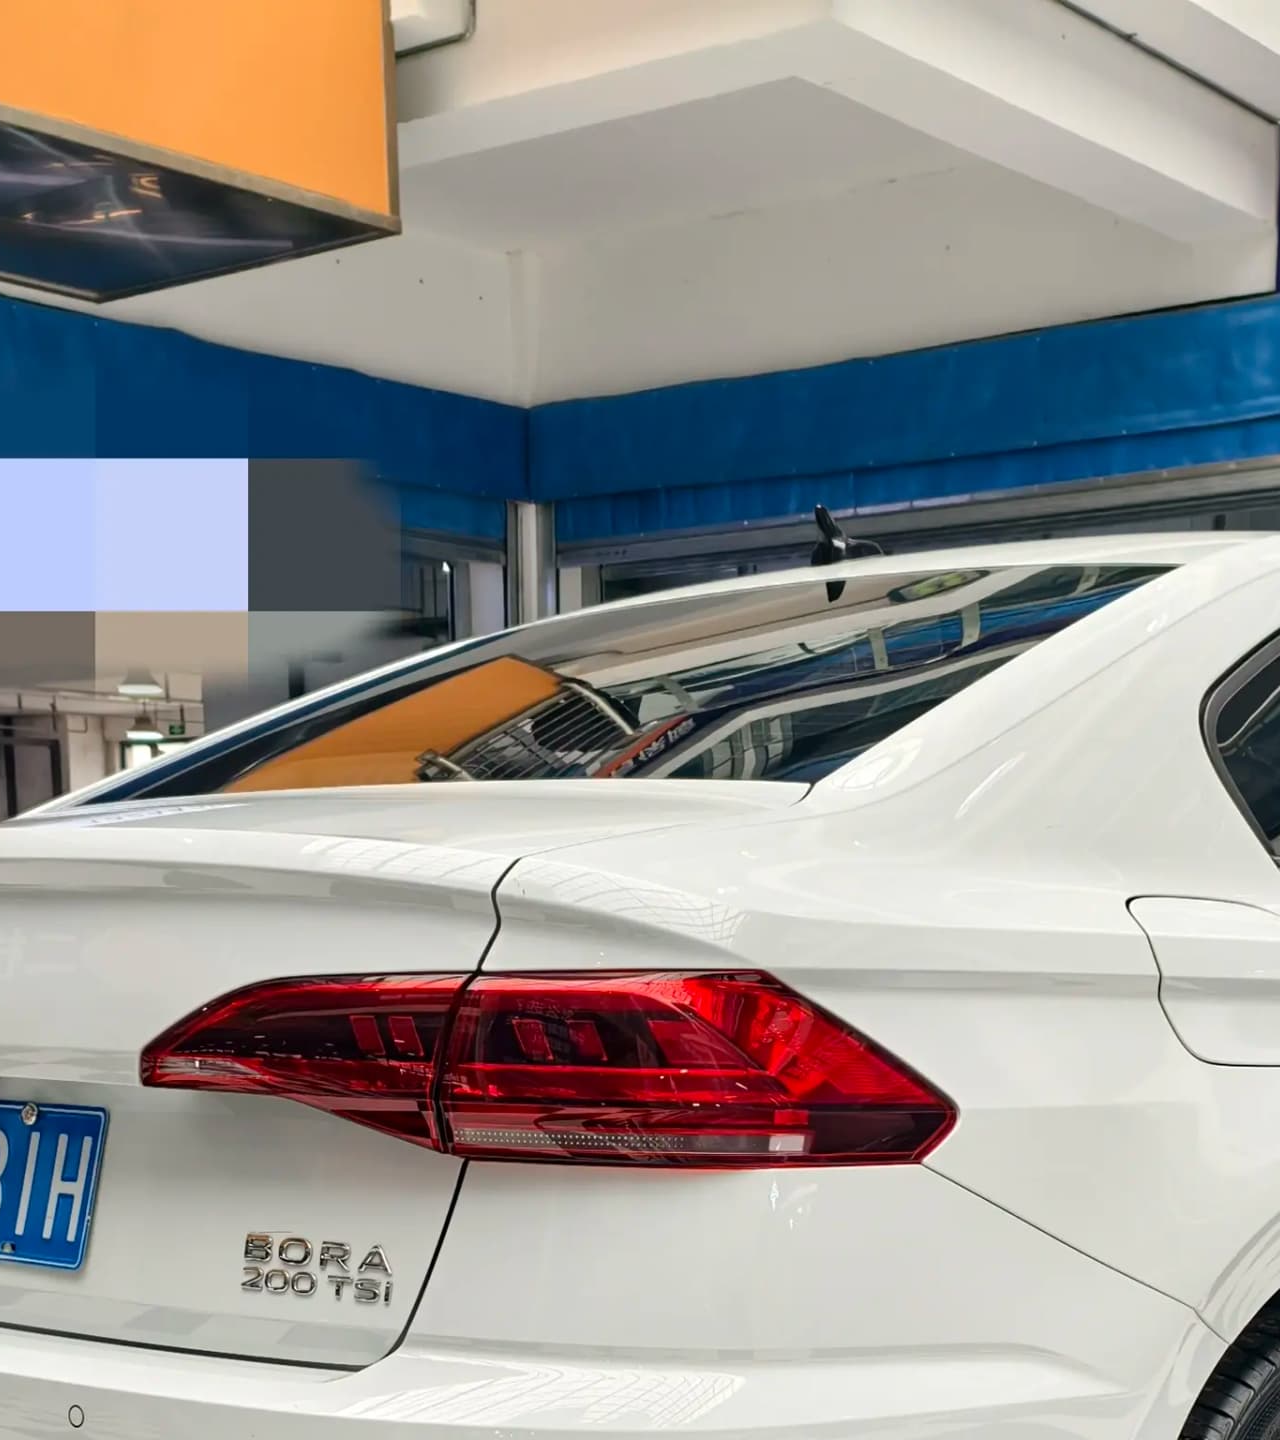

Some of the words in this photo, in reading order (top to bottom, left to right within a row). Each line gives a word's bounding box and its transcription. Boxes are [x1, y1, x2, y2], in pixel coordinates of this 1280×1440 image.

[244, 1233, 393, 1276] BORA
[241, 1266, 317, 1296] 200
[328, 1275, 393, 1307] TSI
